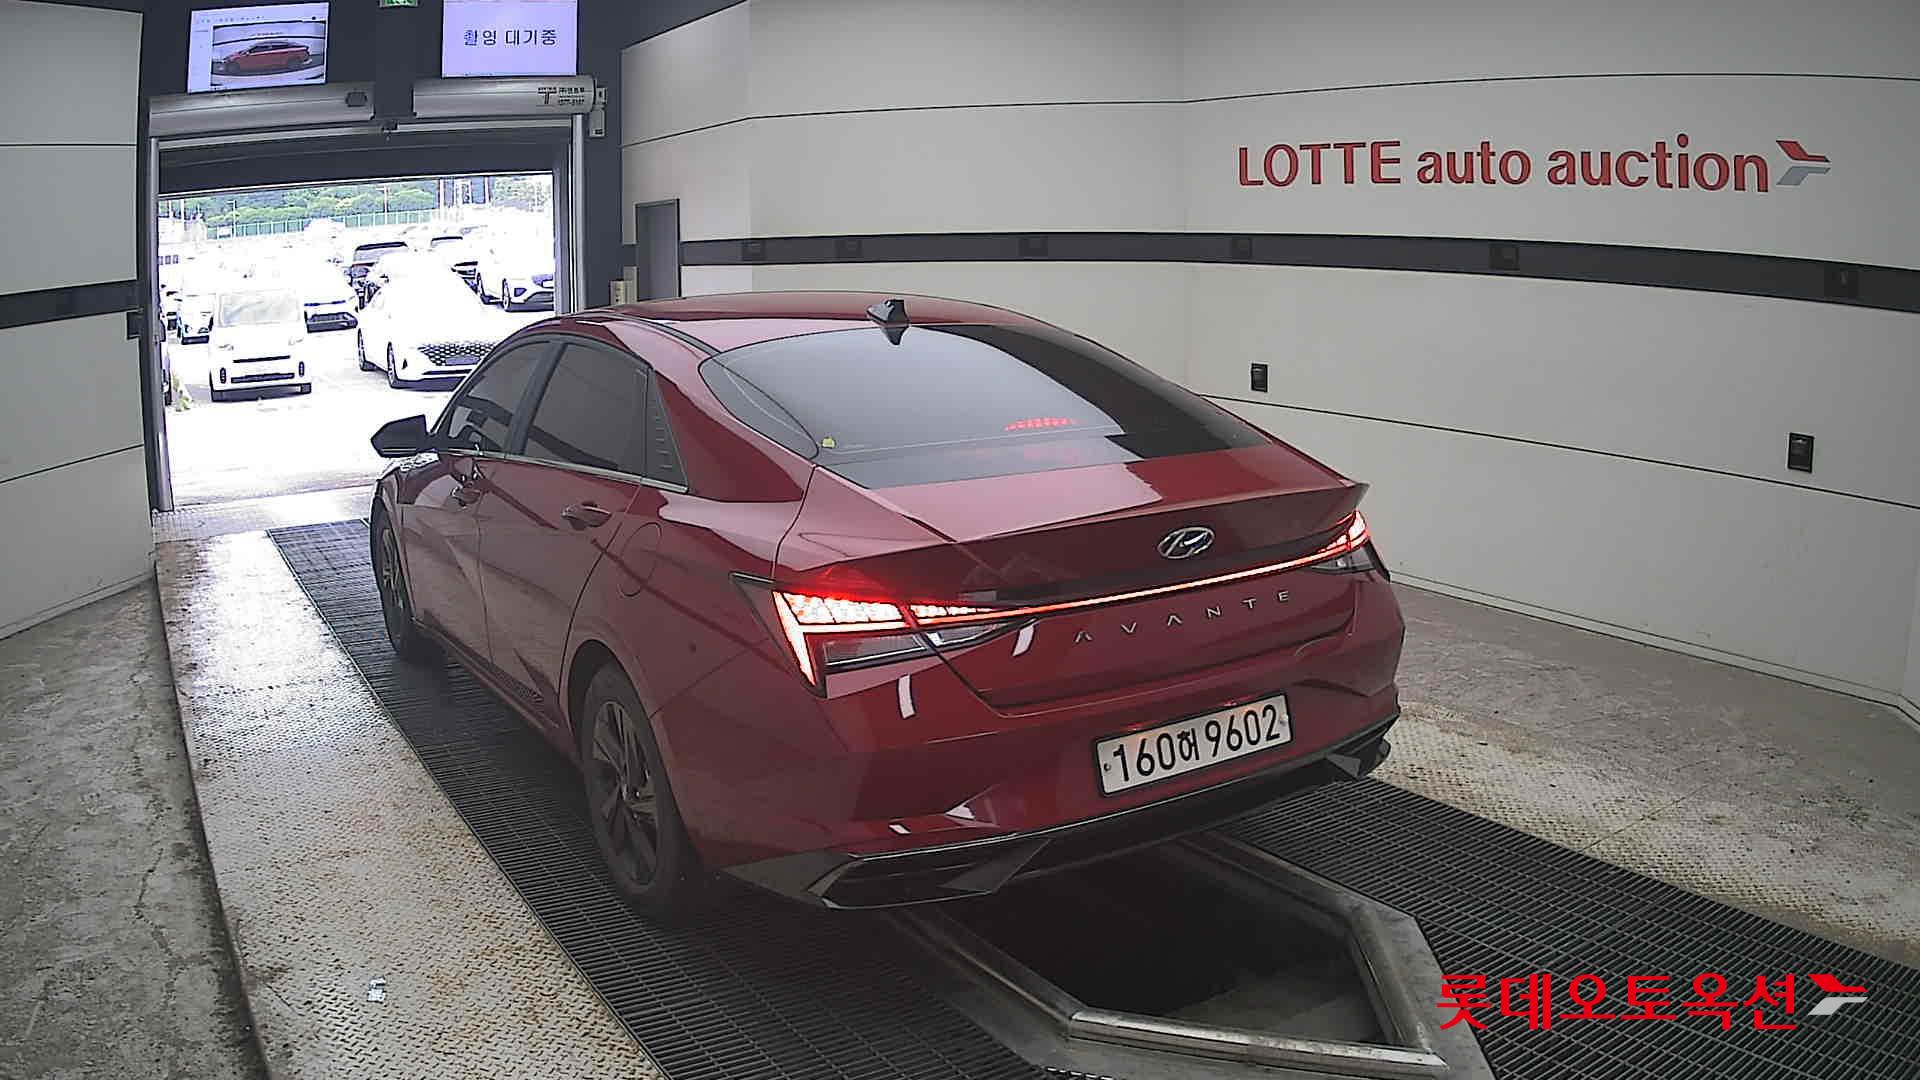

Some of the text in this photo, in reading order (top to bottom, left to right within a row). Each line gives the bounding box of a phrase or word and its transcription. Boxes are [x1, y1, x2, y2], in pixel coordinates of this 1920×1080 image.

[505, 29, 557, 46] 대기중
[1238, 133, 1770, 192] LOTTE auto auction
[1074, 590, 1289, 643] AVANTE
